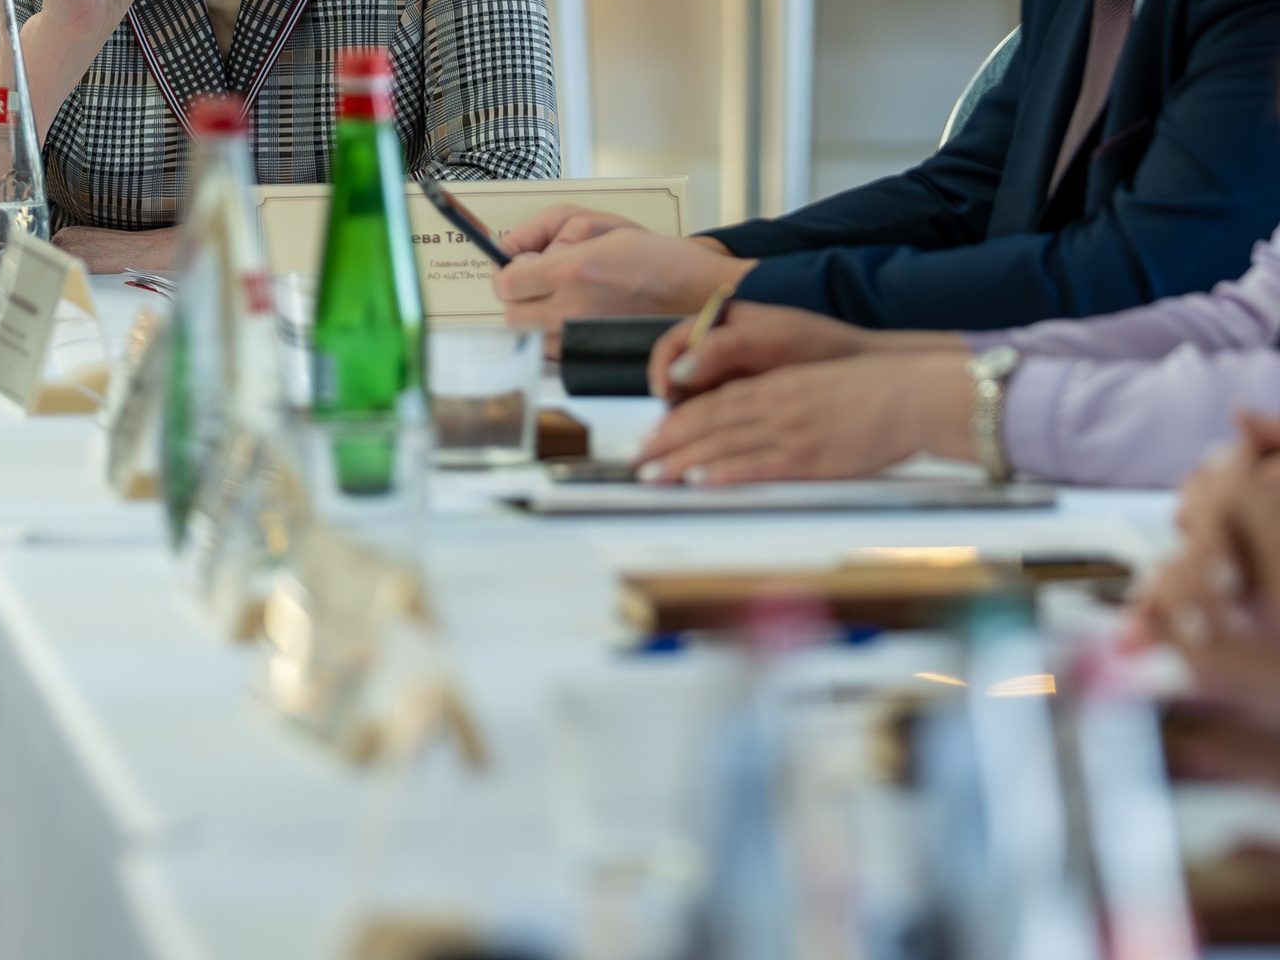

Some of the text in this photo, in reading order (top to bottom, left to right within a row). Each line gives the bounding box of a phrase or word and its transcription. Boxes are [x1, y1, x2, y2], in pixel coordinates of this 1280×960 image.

[411, 233, 441, 244] ева
[430, 259, 468, 268] Главный
[427, 271, 440, 280] АО
